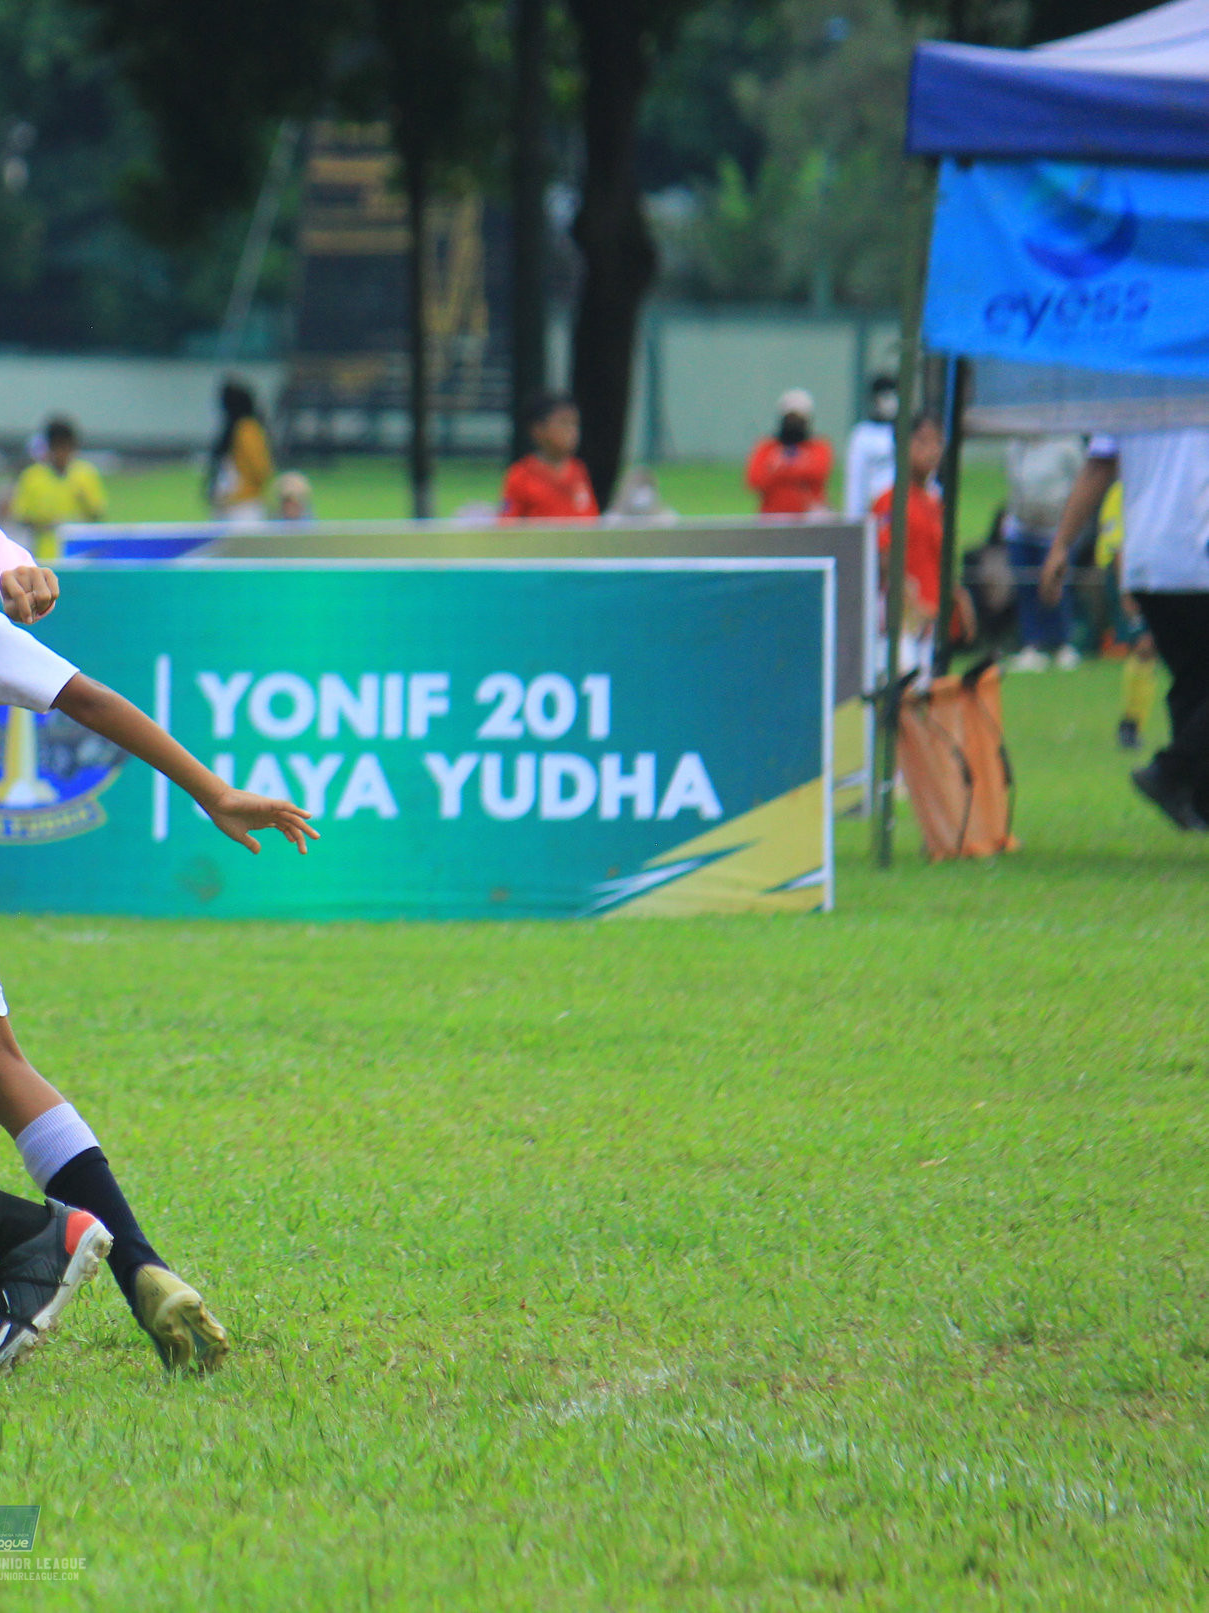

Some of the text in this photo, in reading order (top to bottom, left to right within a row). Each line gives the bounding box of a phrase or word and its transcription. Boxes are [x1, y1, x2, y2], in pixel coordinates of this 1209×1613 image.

[196, 671, 611, 741] YONIF 201
[423, 752, 724, 820] YUDHA
